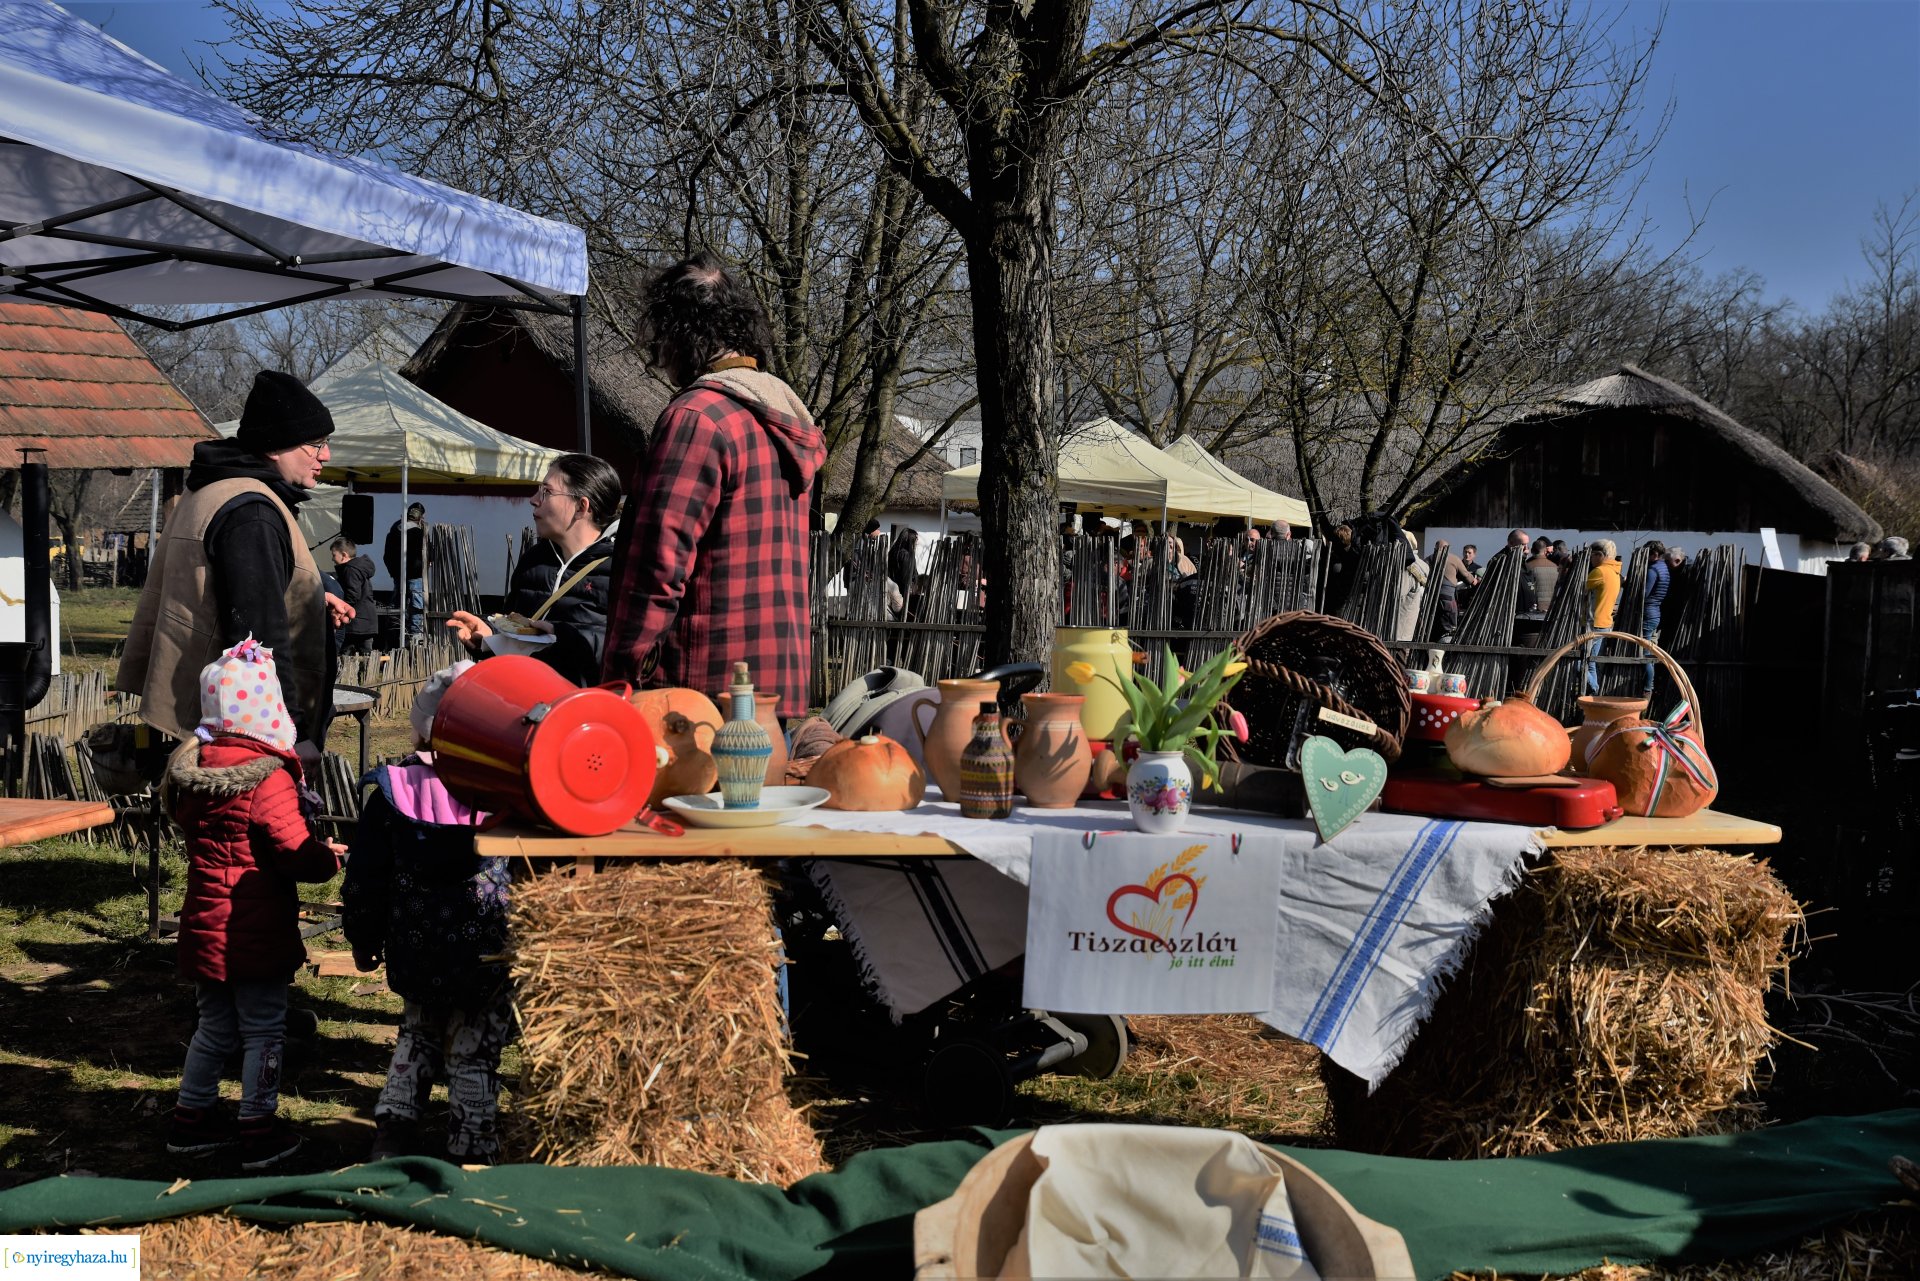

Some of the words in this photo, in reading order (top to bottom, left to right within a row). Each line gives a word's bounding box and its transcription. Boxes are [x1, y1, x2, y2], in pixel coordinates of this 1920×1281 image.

[1068, 931, 1239, 953] Tiszaeszlár
[1169, 955, 1183, 970] jó
[1188, 955, 1204, 968] itt
[1209, 954, 1235, 968] élni
